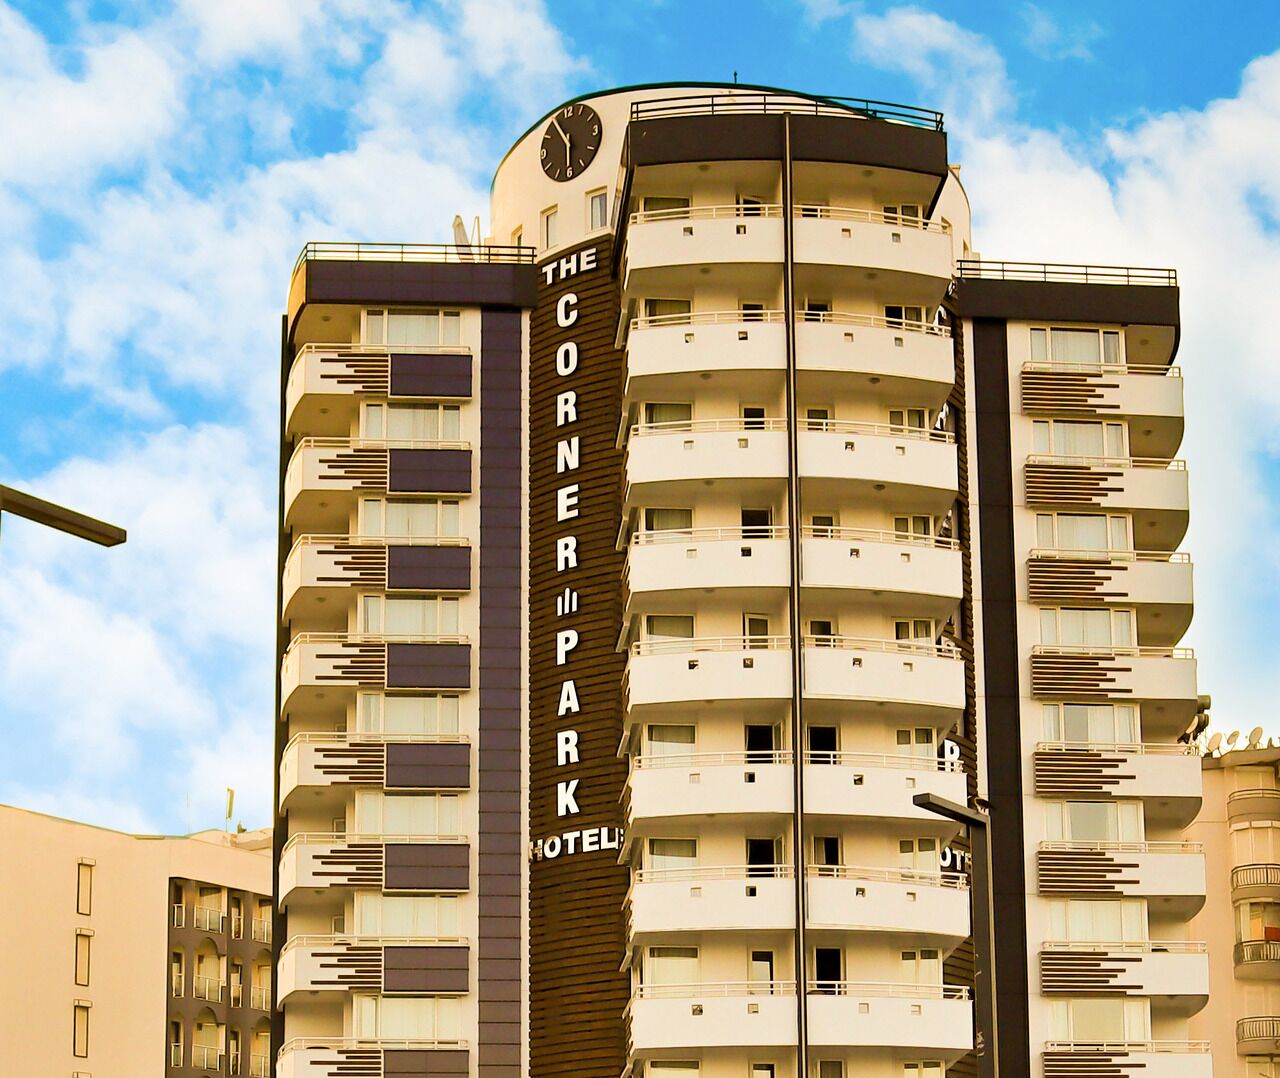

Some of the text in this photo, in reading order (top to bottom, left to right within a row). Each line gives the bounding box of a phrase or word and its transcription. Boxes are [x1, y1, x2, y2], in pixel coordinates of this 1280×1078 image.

[542, 248, 597, 285] THE
[556, 293, 580, 572] CORNER
[556, 629, 580, 817] PARK
